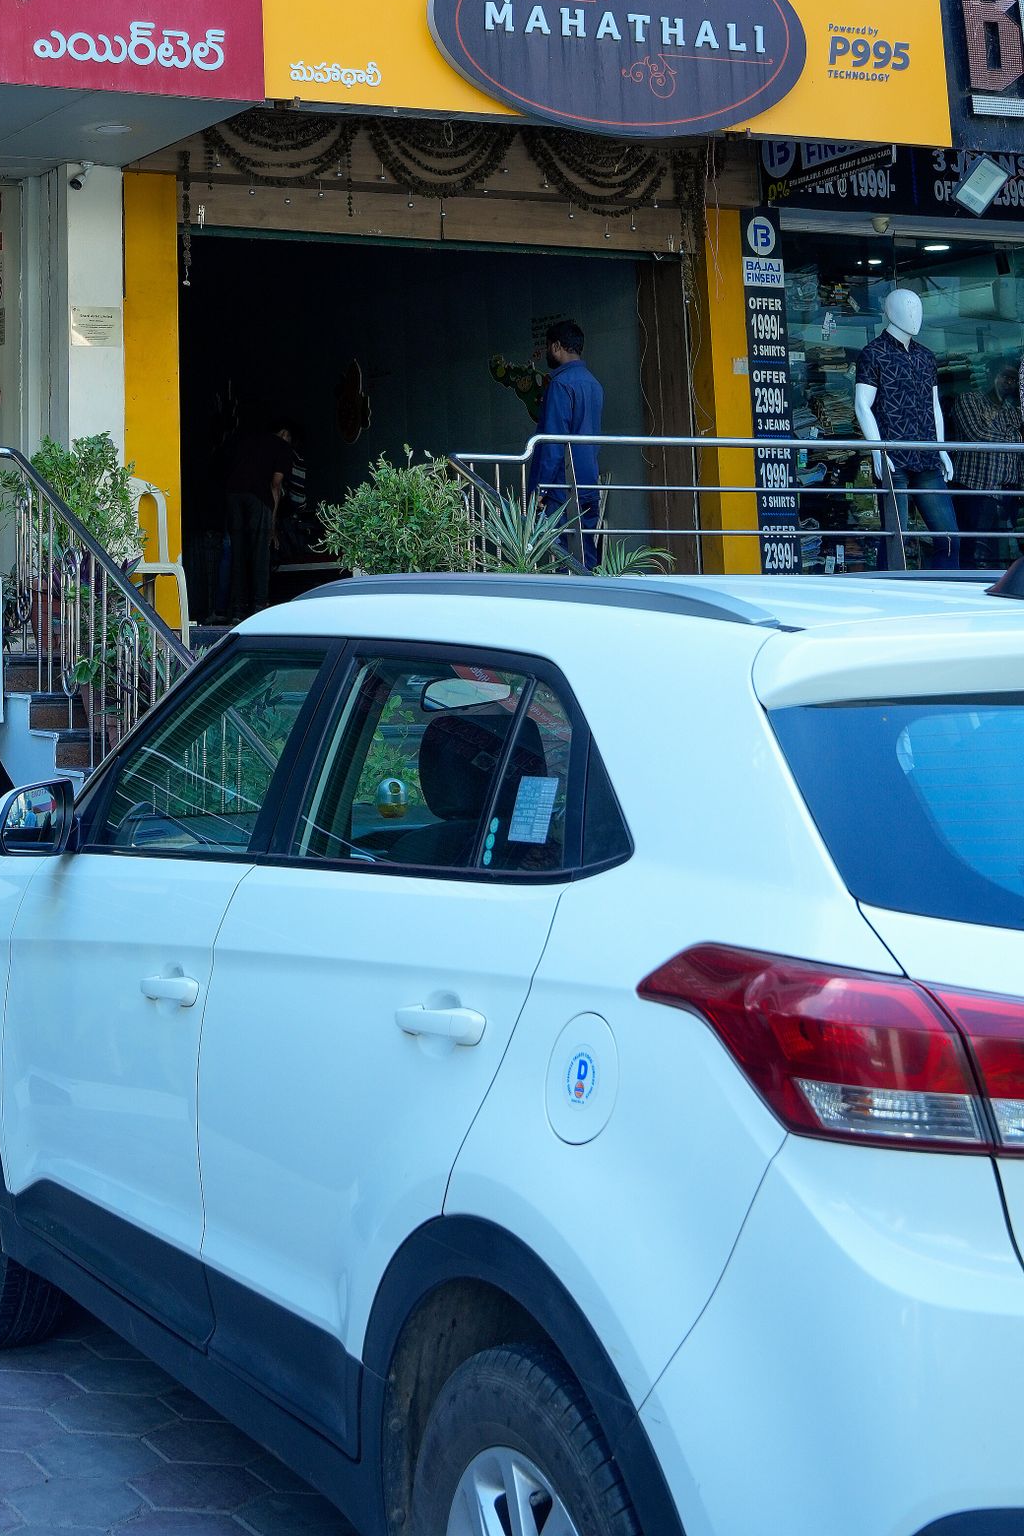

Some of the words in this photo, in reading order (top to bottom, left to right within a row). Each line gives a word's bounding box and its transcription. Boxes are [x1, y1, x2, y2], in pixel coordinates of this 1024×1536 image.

[484, 0, 767, 54] MAHATHALI
[828, 23, 866, 35] Powered
[868, 26, 879, 37] by
[829, 36, 910, 71] P995
[828, 70, 890, 82] TECHNOLOGY
[746, 261, 781, 272] BAJAJ
[746, 272, 782, 284] FINSERV
[748, 297, 782, 311] OFFER
[753, 345, 758, 356] 3
[759, 345, 786, 357] SHIRTS
[752, 370, 787, 384] OFFER
[757, 418, 763, 430] 3
[764, 419, 791, 431] JEANS
[757, 447, 792, 460] OFFER
[762, 495, 768, 508] 3
[768, 496, 796, 509] SHIRTS
[577, 1058, 589, 1081] D
